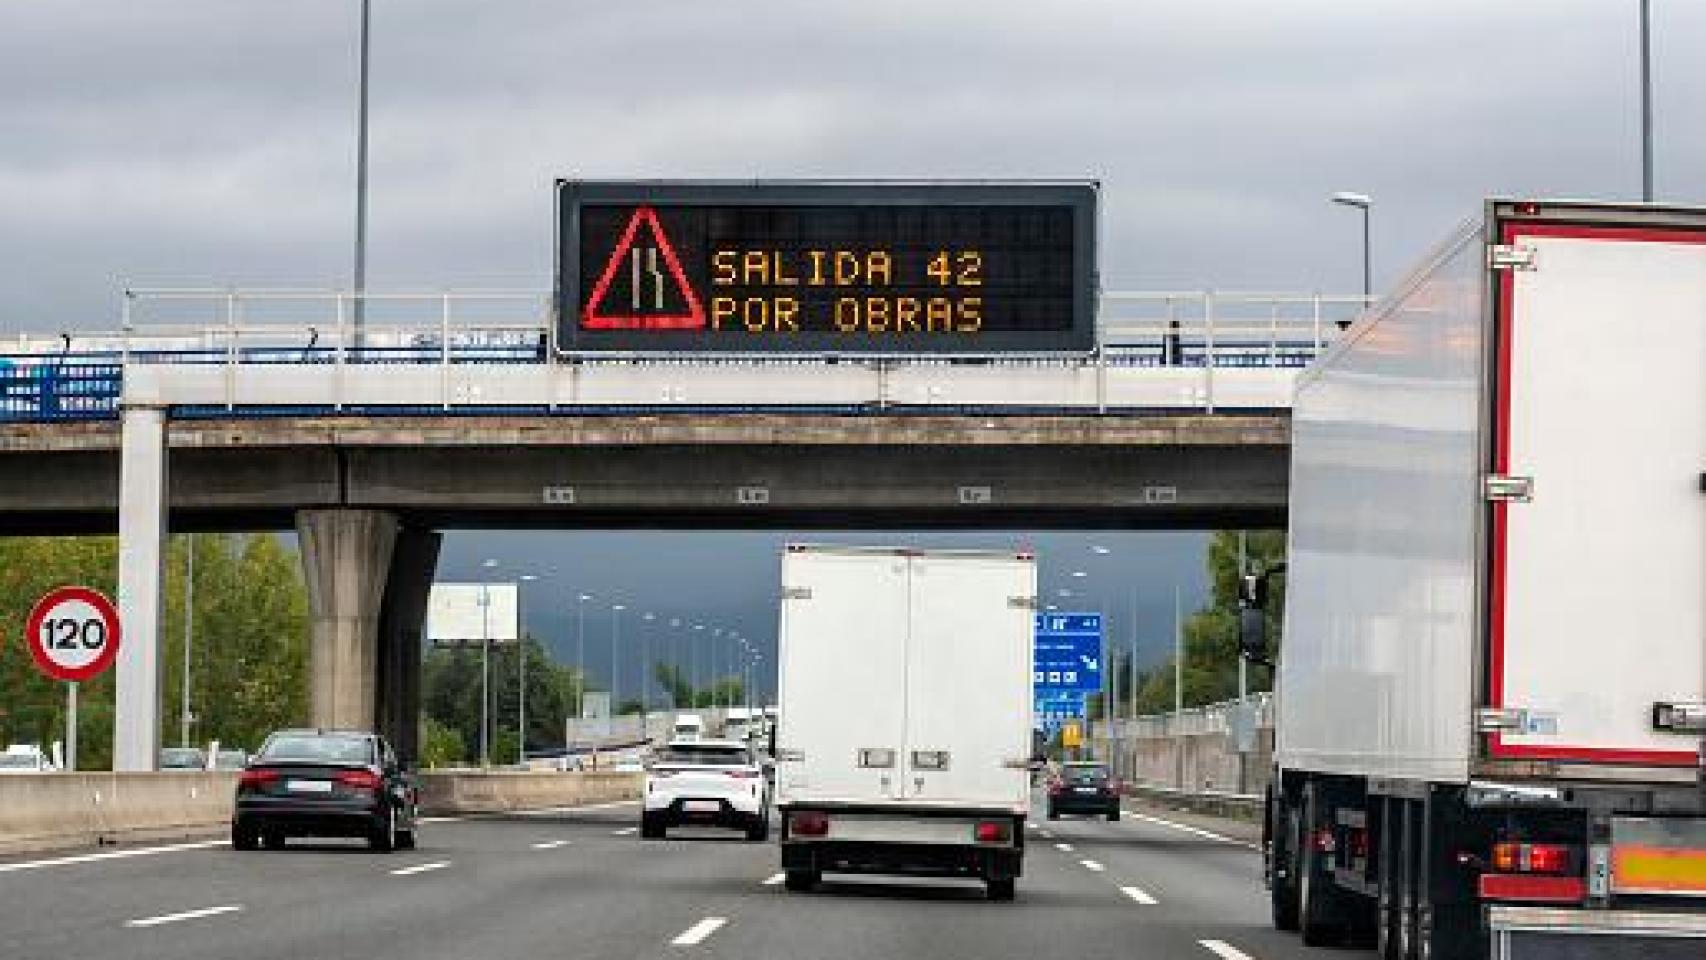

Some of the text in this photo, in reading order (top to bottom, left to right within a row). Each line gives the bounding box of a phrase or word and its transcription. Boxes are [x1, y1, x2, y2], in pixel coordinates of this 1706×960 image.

[711, 251, 983, 286] SALIDA 42
[711, 297, 983, 332] POR OBRAS
[43, 618, 105, 649] 120
